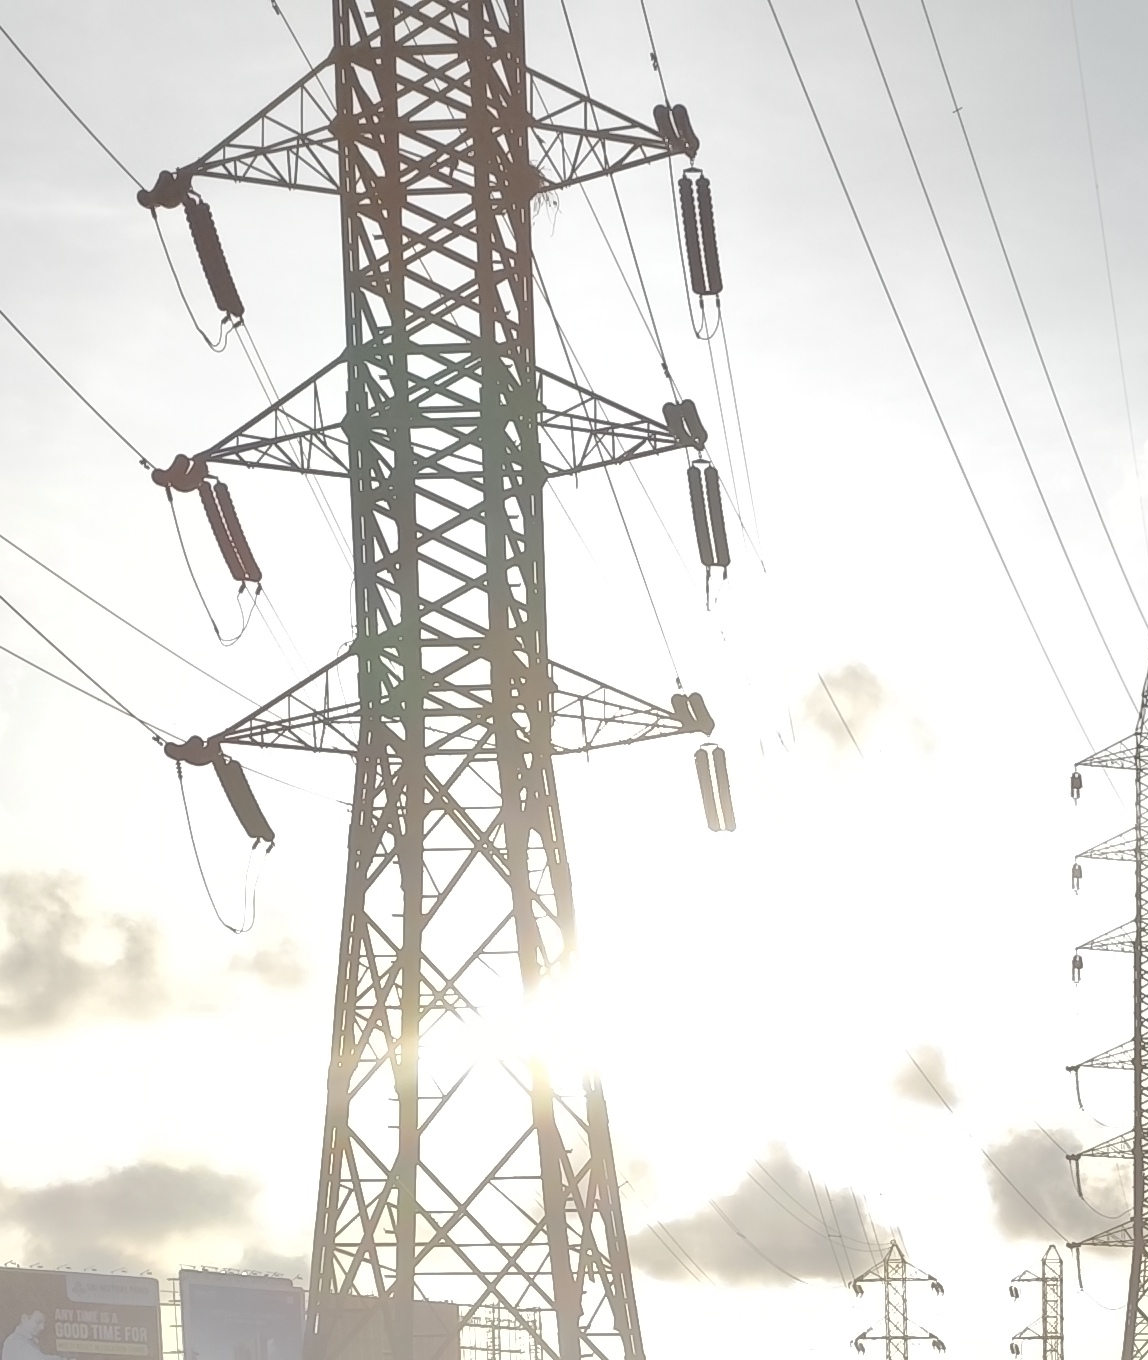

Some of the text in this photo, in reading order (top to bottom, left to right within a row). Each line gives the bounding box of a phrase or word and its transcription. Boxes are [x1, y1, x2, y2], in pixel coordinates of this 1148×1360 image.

[55, 1308, 119, 1324] ANY TIME IS A
[55, 1322, 148, 1342] GOOD TIME FOR
